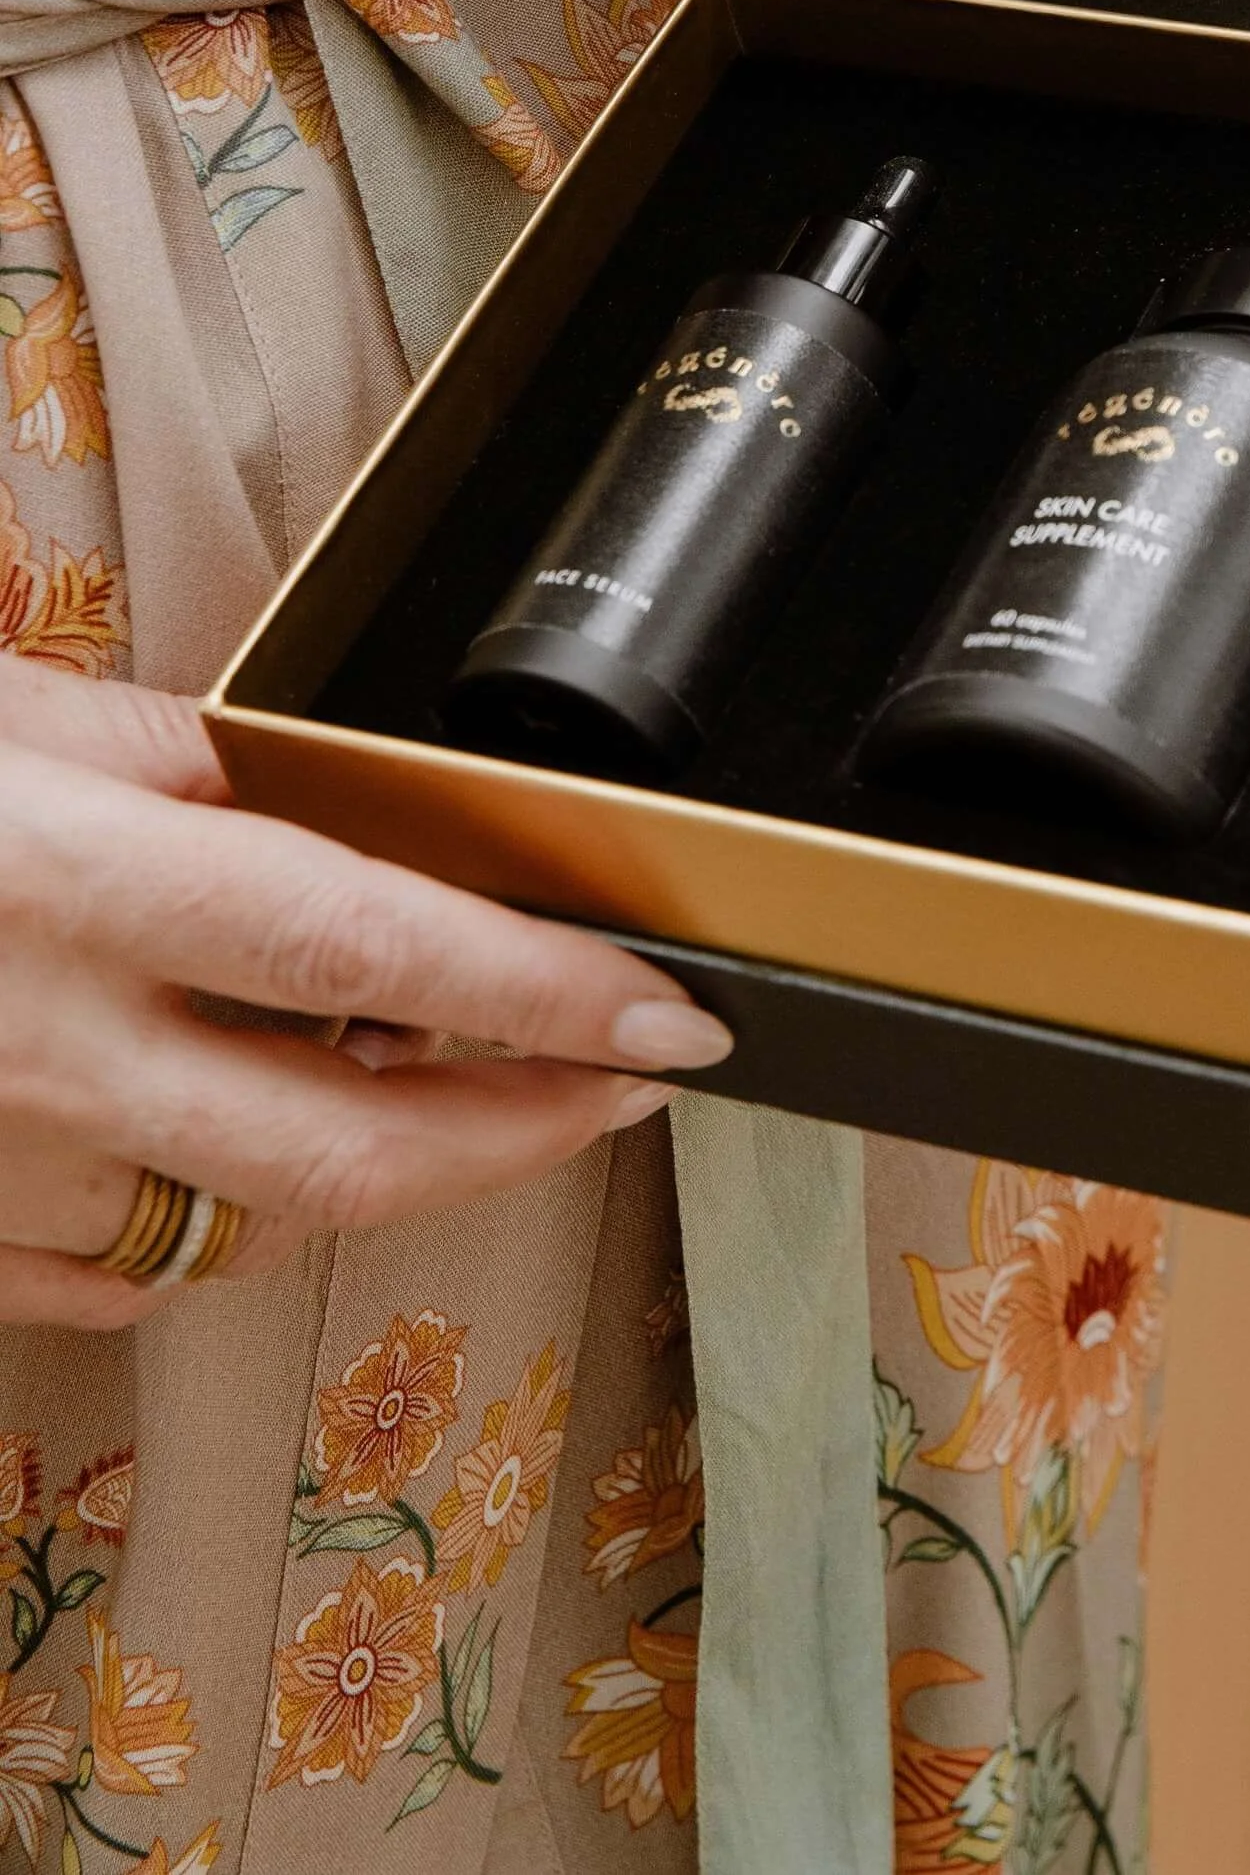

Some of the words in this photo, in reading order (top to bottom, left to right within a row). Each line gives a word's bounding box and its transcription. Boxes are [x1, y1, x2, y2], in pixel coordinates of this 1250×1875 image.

[1033, 495, 1097, 518] SKIN
[1097, 499, 1172, 536] CARE
[1008, 521, 1171, 567] SUPPLEMENT
